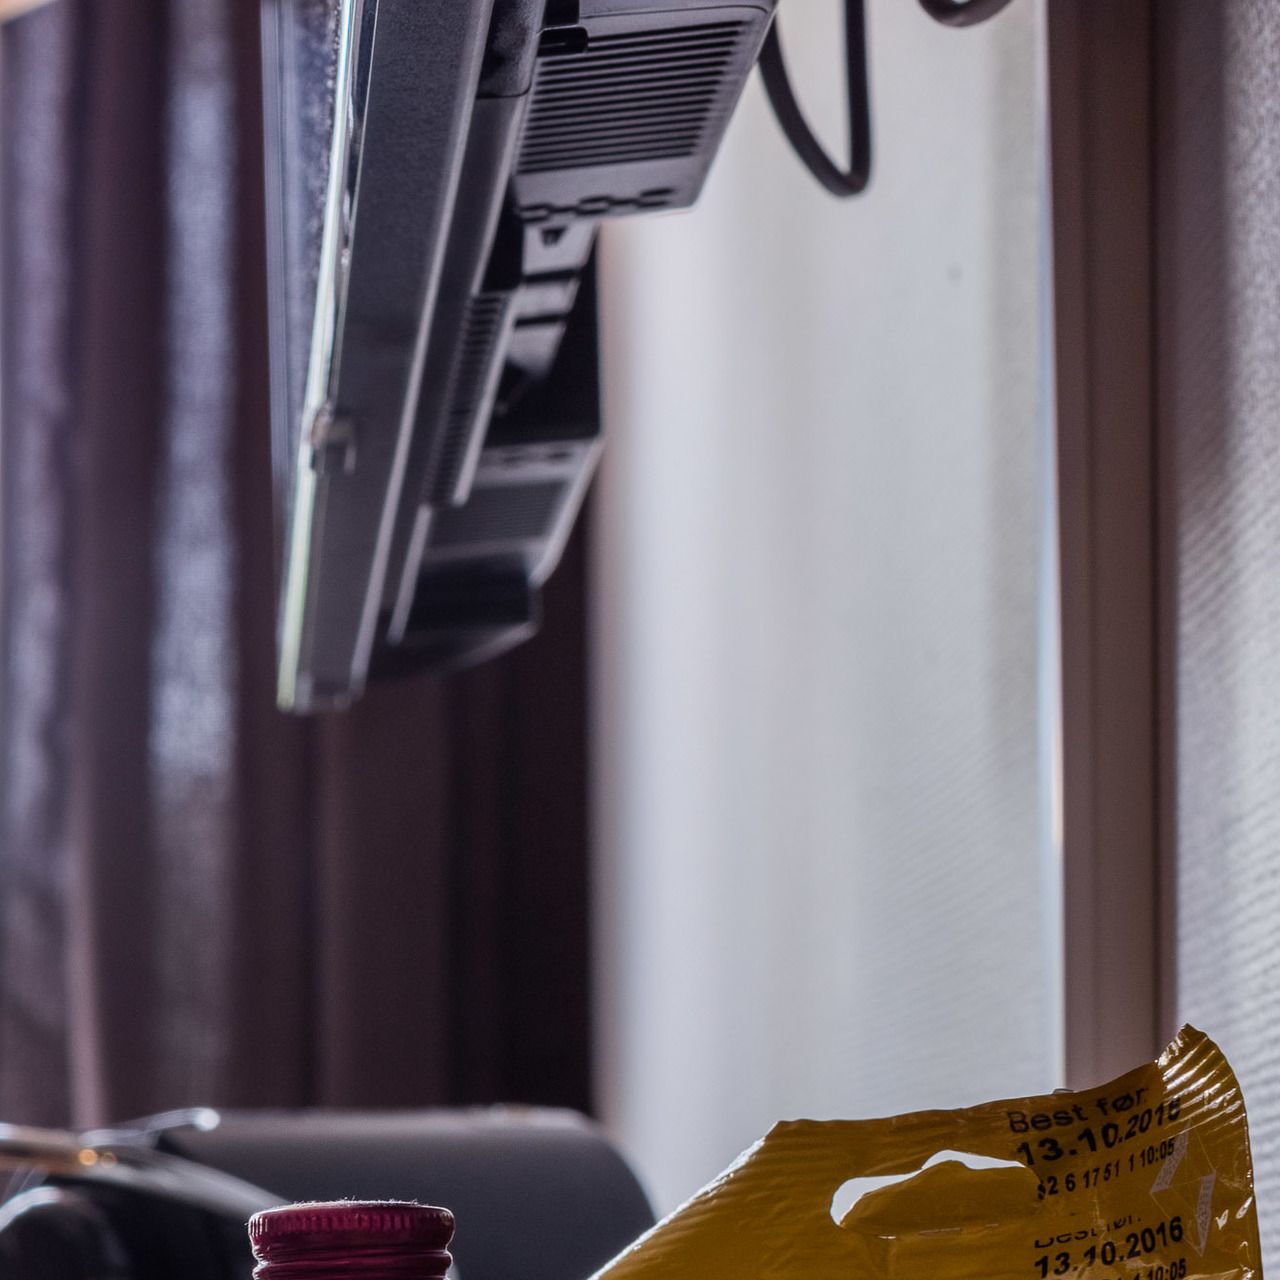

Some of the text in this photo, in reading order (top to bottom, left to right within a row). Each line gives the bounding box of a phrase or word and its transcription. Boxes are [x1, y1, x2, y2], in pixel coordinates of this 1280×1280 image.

[1007, 1104, 1089, 1133] Best
[1140, 1138, 1175, 1167] 10:05
[1034, 1216, 1183, 1279] 13.10.2016
